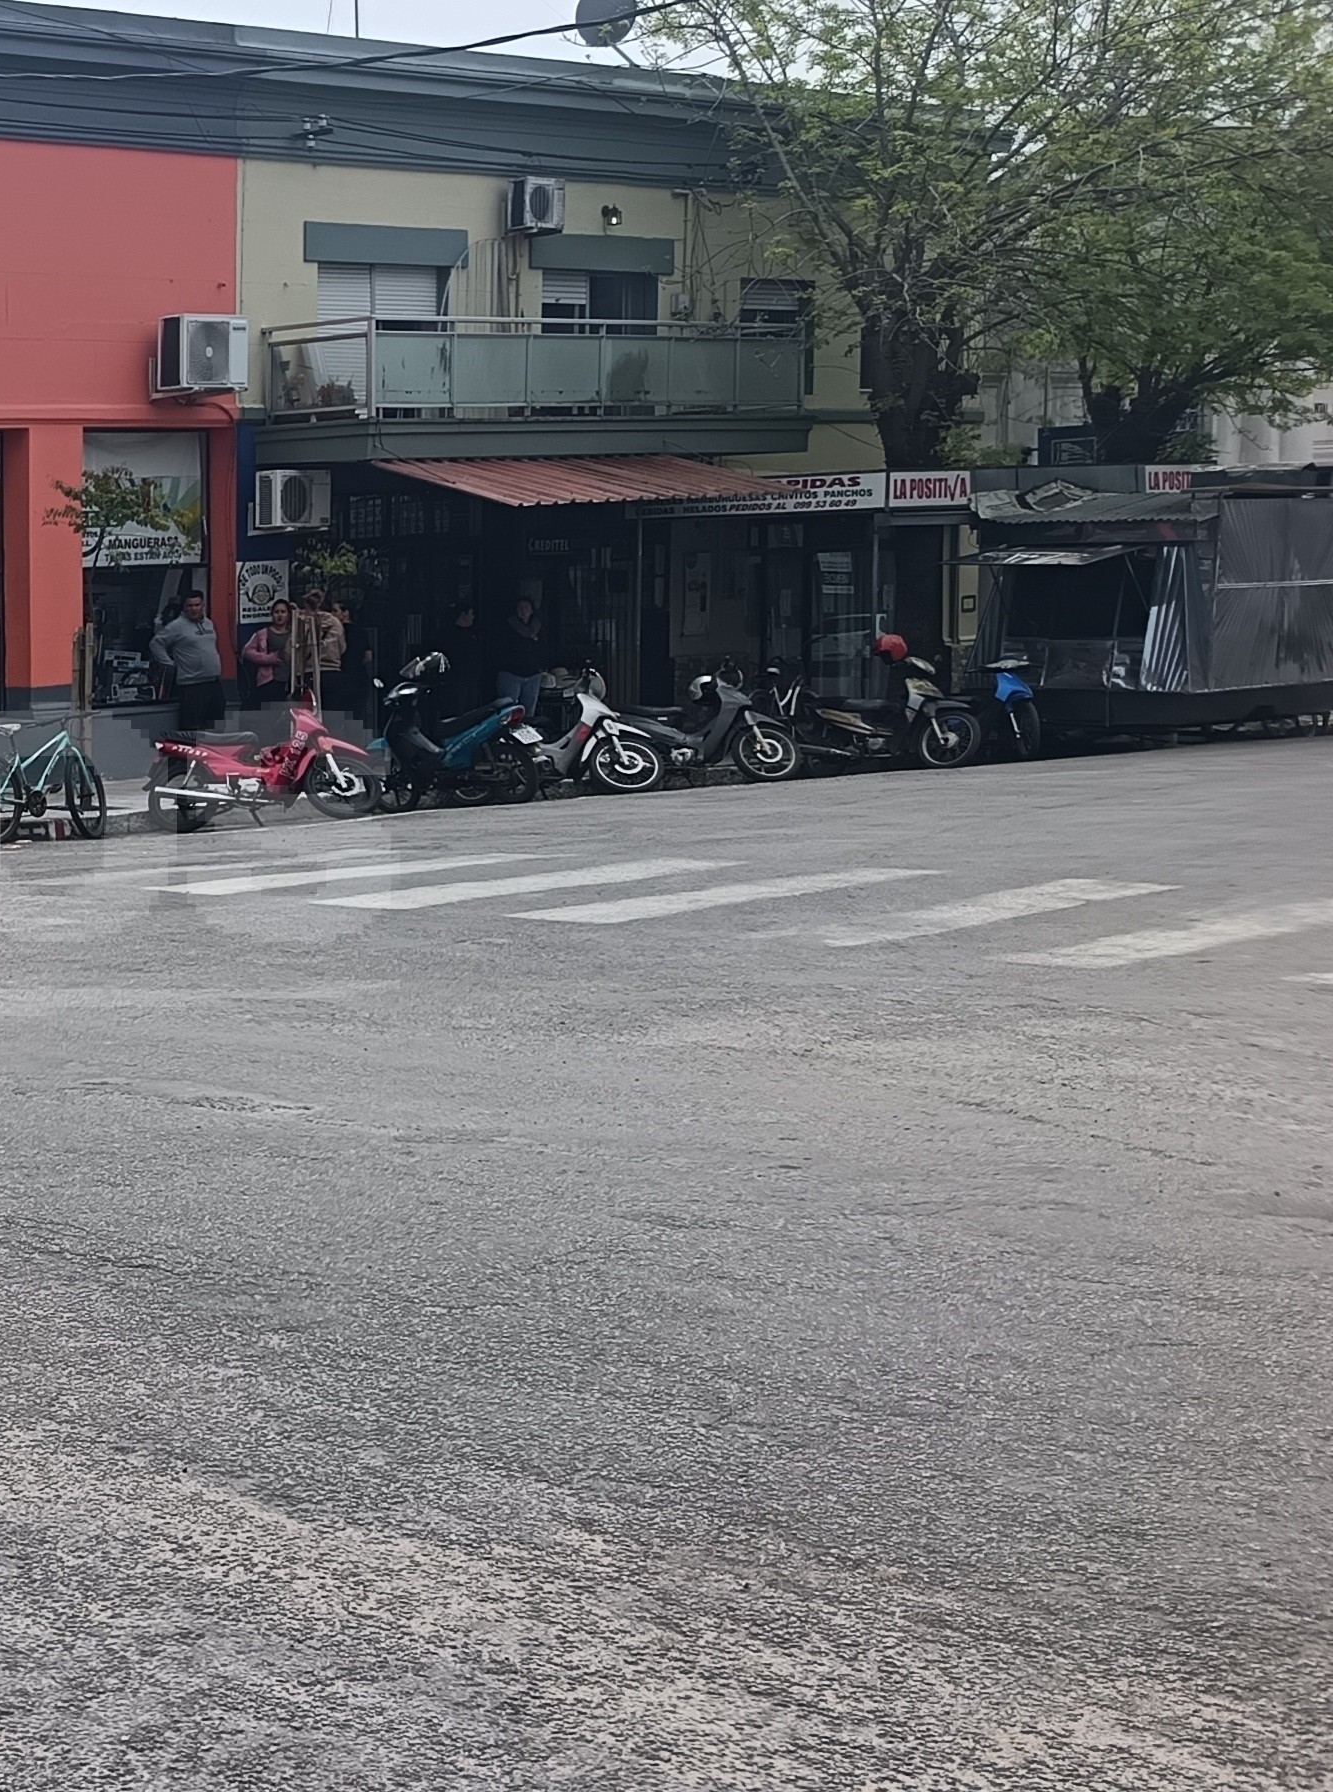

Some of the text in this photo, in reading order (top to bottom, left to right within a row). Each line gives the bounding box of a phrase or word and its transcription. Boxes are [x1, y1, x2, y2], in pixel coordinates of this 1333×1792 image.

[893, 479, 907, 500] LA
[1148, 471, 1161, 491] LA
[823, 488, 873, 499] PANCHOS
[683, 504, 728, 514] HELADOS
[728, 502, 773, 512] PEDIDOS
[774, 502, 787, 511] AL
[793, 501, 813, 510] 099
[813, 500, 828, 509] 53
[844, 499, 858, 507] 49
[290, 730, 309, 756] 125
